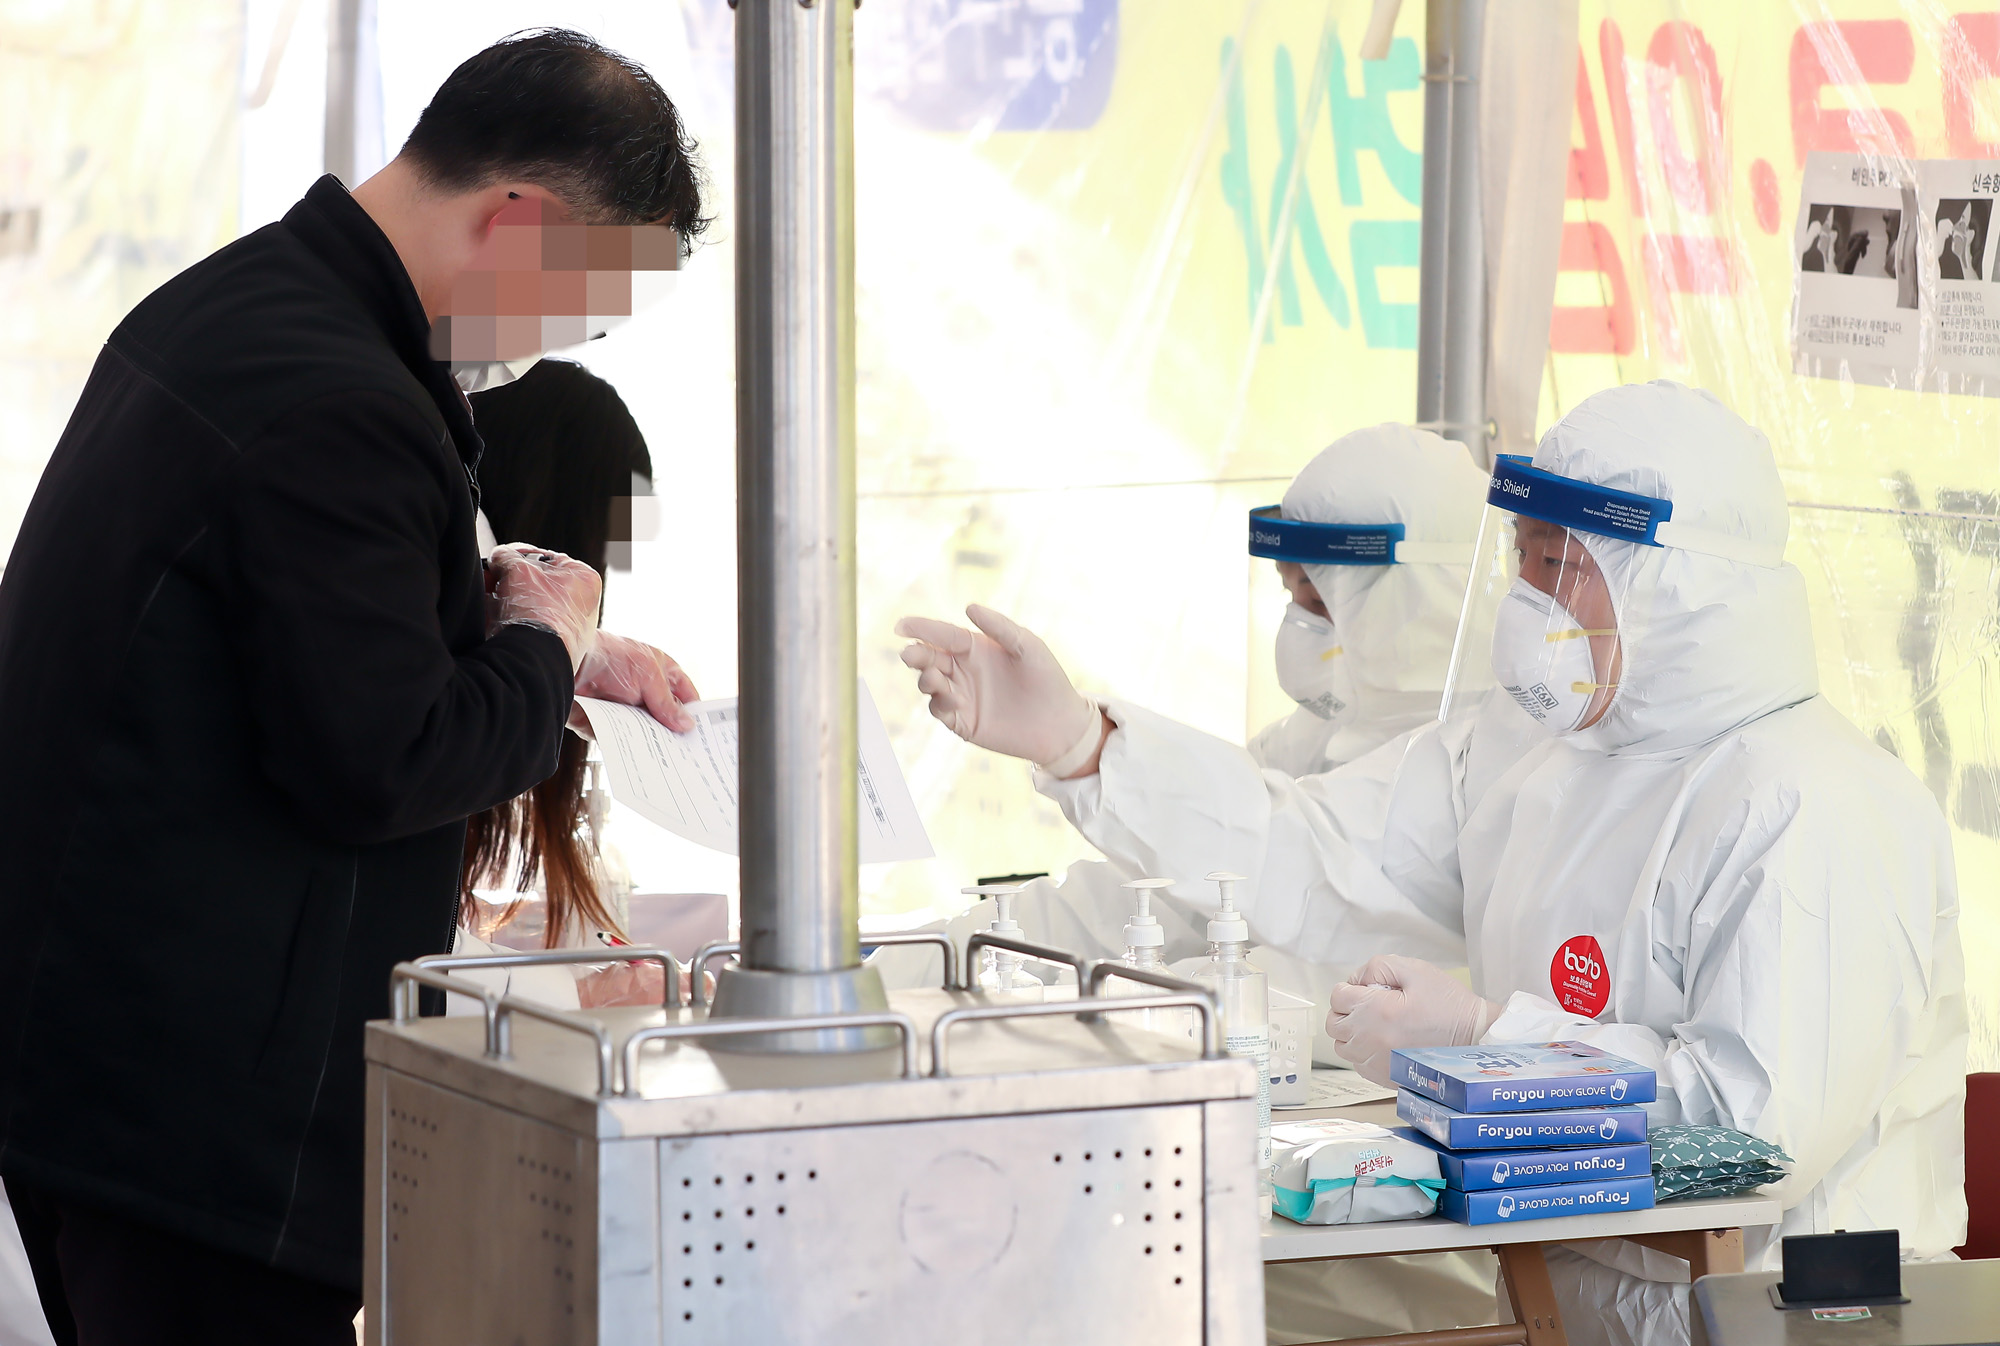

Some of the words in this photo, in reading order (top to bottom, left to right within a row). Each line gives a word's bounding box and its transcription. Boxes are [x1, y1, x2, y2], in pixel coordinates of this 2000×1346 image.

[1503, 478, 1531, 499] Shield
[1255, 531, 1281, 546] Shield
[1534, 686, 1555, 707] N95
[1408, 1066, 1428, 1088] Foryou
[1492, 1087, 1545, 1103] Foryou
[1550, 1088, 1574, 1098] POLY
[1575, 1086, 1606, 1097] GLOVE
[1478, 1124, 1532, 1140] Foryou
[1538, 1126, 1562, 1135] POLY
[1564, 1124, 1596, 1134] GLOVE
[1514, 1164, 1545, 1176] GLOVE
[1546, 1162, 1569, 1172] POLY
[1574, 1156, 1626, 1171] Foryou
[1519, 1198, 1550, 1210] GLOVE
[1551, 1196, 1574, 1206] POLY
[1579, 1190, 1630, 1205] Foryou
